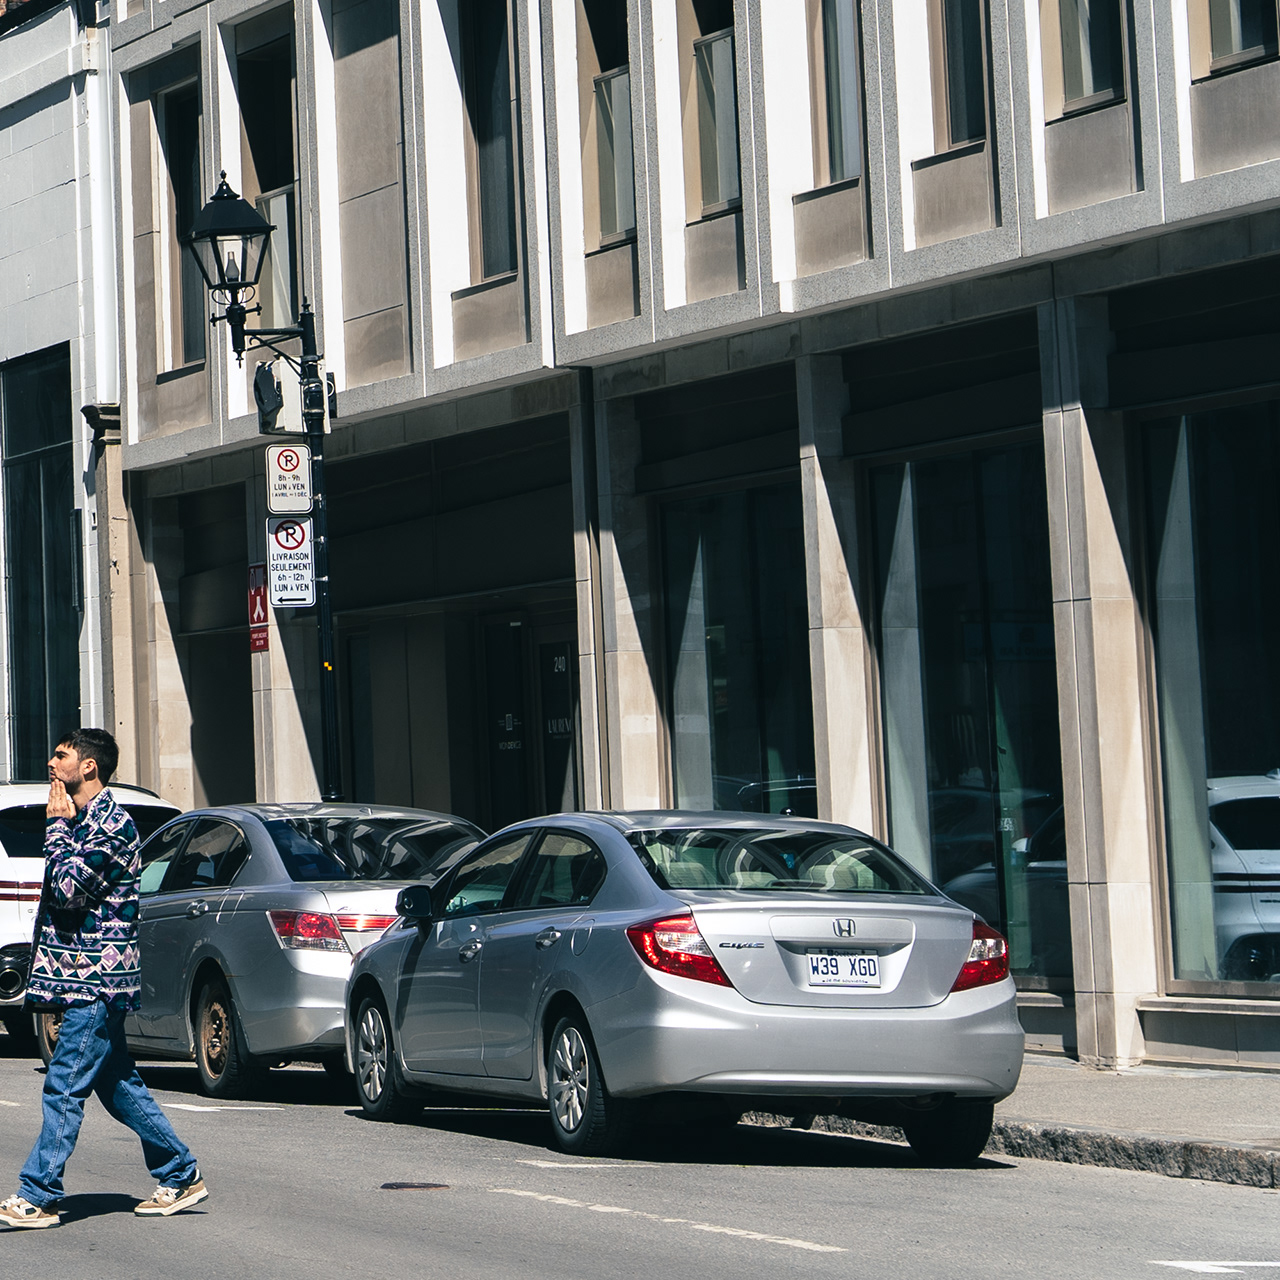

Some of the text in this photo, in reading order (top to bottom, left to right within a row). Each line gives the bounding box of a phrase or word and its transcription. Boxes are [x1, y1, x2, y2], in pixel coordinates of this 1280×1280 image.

[272, 552, 309, 561] LIVRAISON
[271, 562, 312, 571] SEULEMENT
[554, 656, 566, 672] 240
[810, 956, 877, 977] W39 XGD
